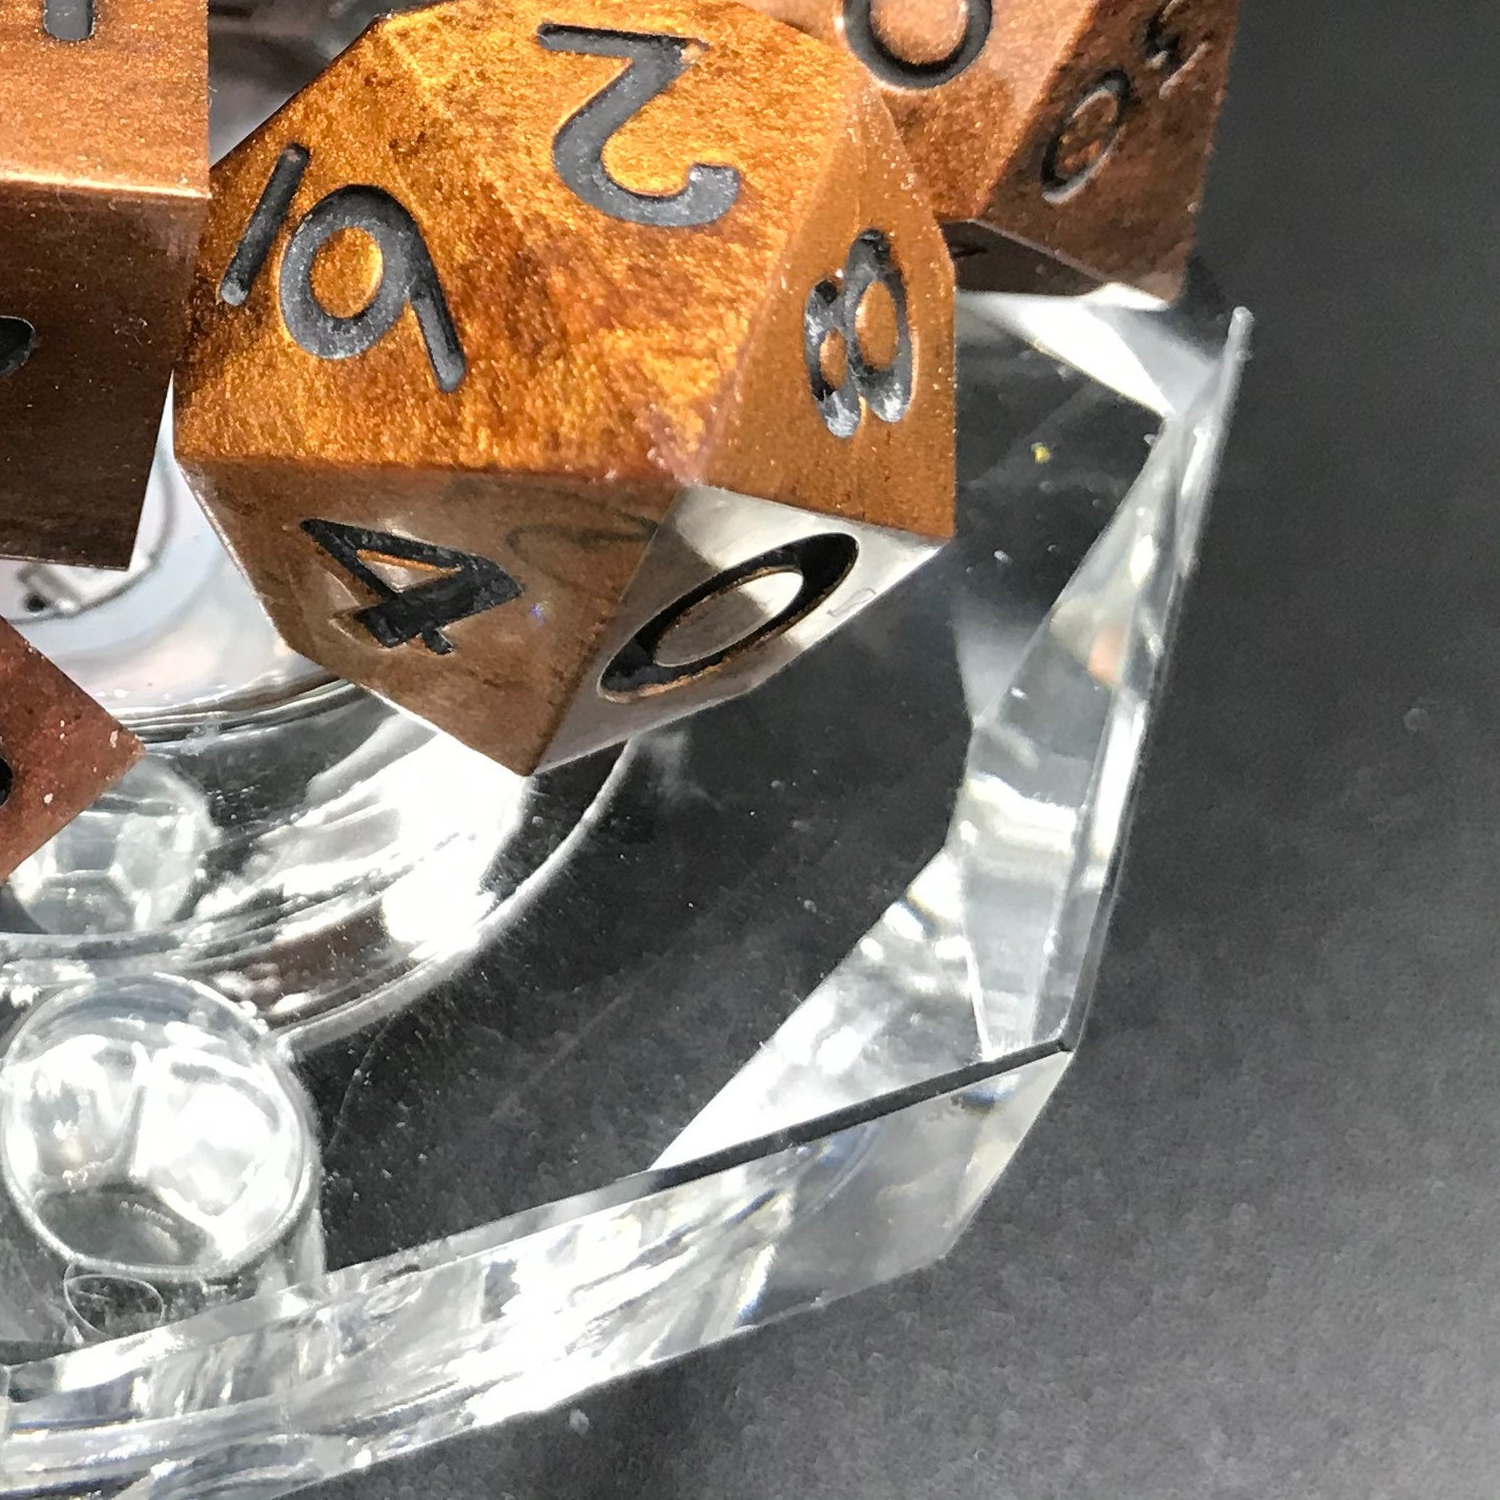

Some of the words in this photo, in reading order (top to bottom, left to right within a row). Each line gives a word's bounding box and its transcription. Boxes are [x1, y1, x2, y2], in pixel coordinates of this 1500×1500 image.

[534, 20, 740, 229] 2
[804, 226, 913, 439] 8
[299, 516, 527, 656] 4
[597, 532, 860, 703] 0
